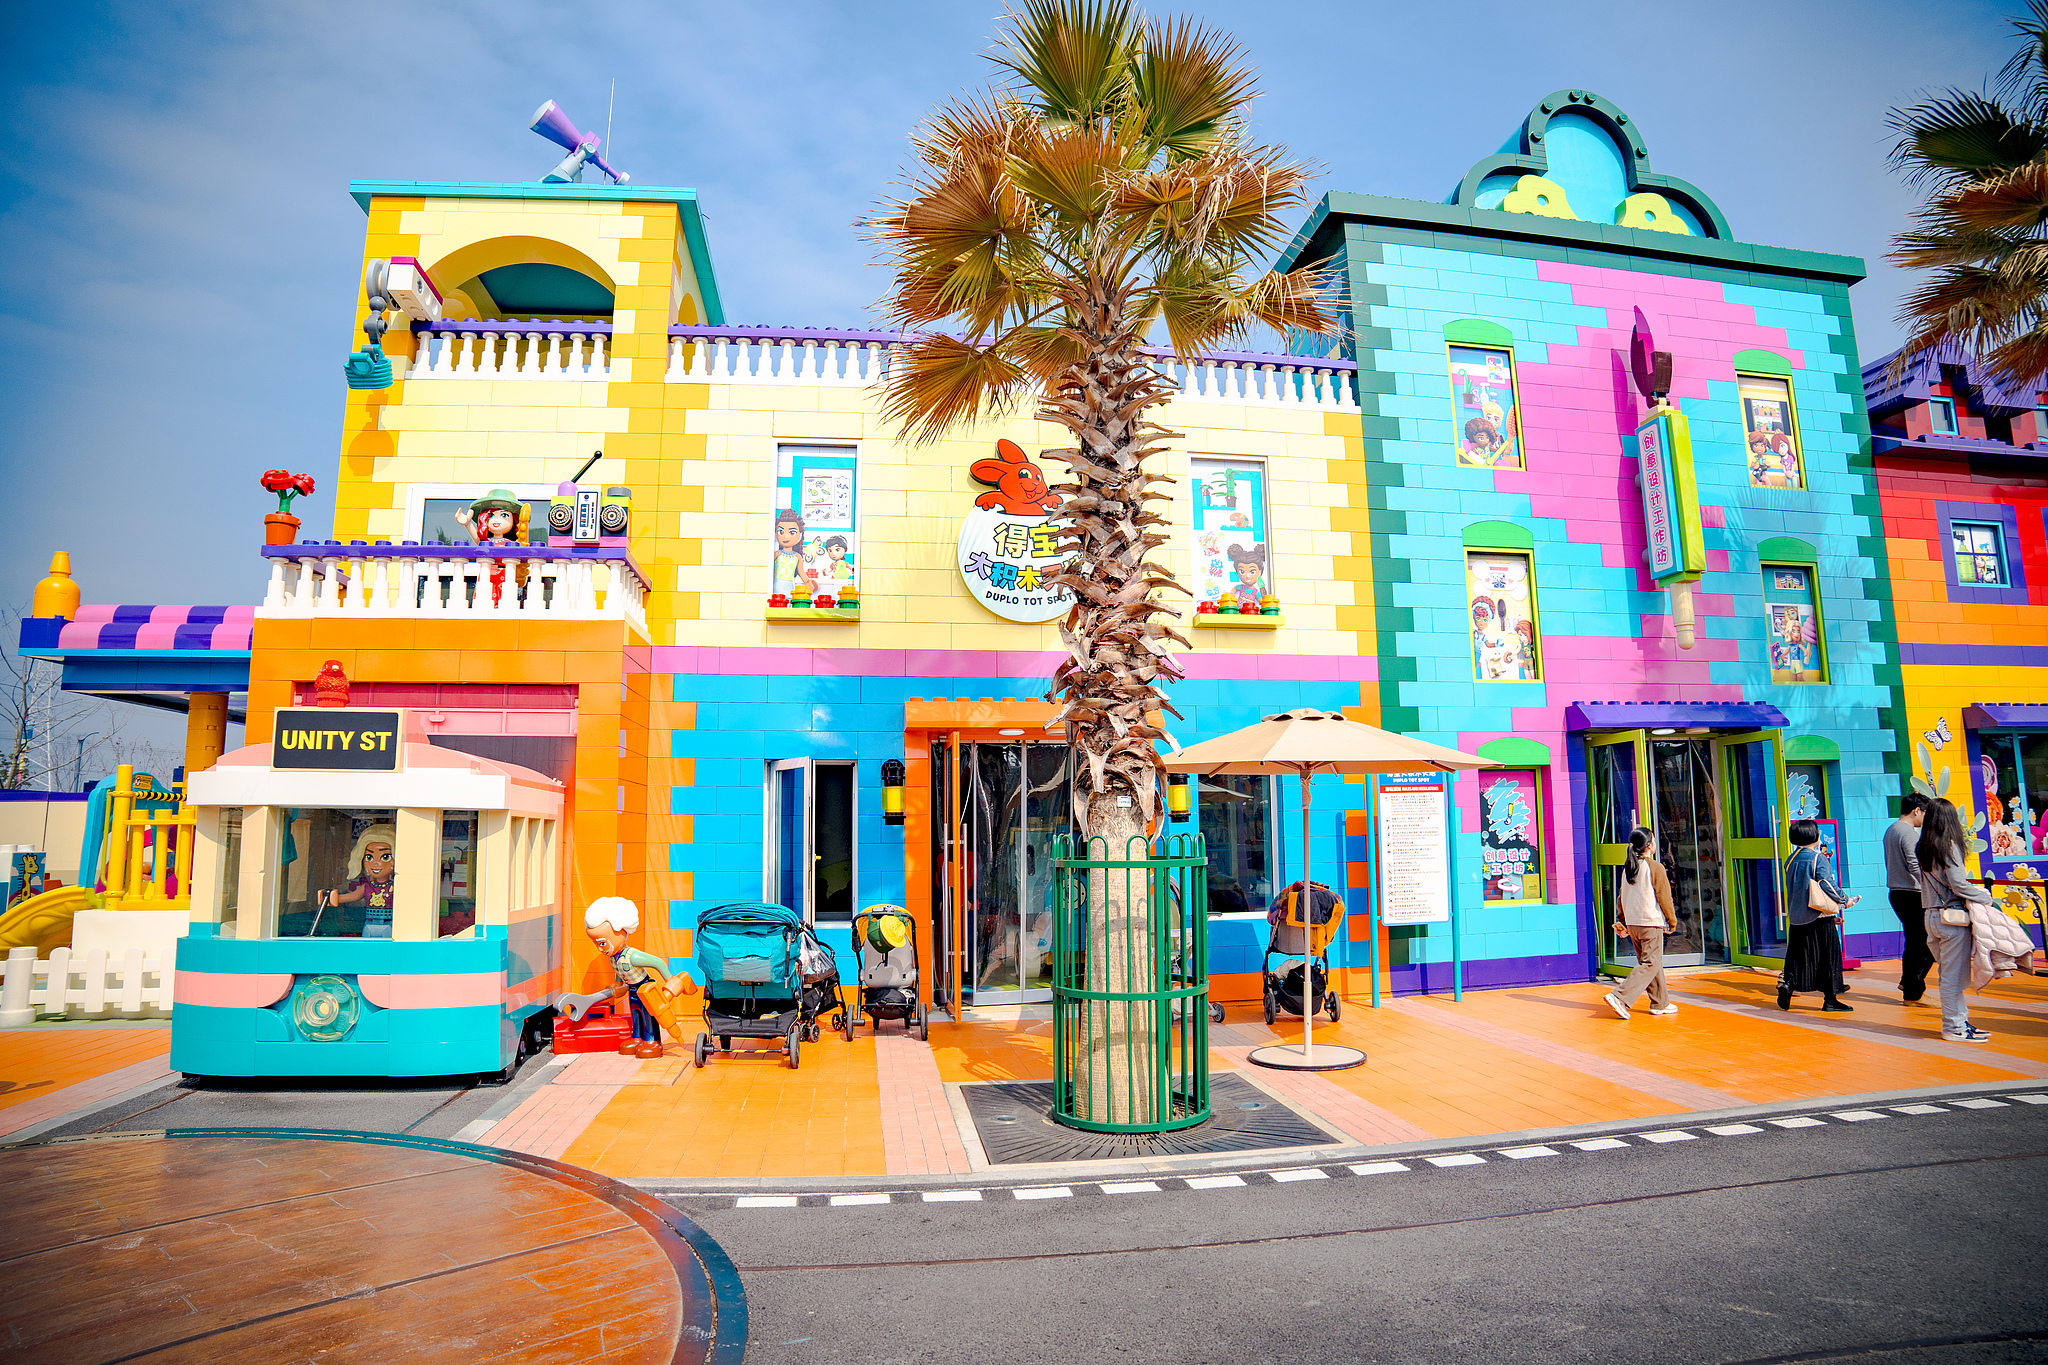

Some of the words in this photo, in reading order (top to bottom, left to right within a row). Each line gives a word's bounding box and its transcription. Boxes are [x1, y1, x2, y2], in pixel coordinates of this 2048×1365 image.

[1642, 431, 1669, 564] 创意设计工作坊
[993, 522, 1063, 558] 得宝
[964, 551, 1083, 592] 大积木
[985, 591, 1019, 605] DUPLO
[1023, 597, 1043, 606] TOT
[1047, 592, 1073, 605] SPOT
[281, 729, 355, 751] UNITY
[359, 731, 393, 751] ST
[1484, 848, 1531, 863] 创意设计
[1491, 861, 1526, 876] 工作坊
